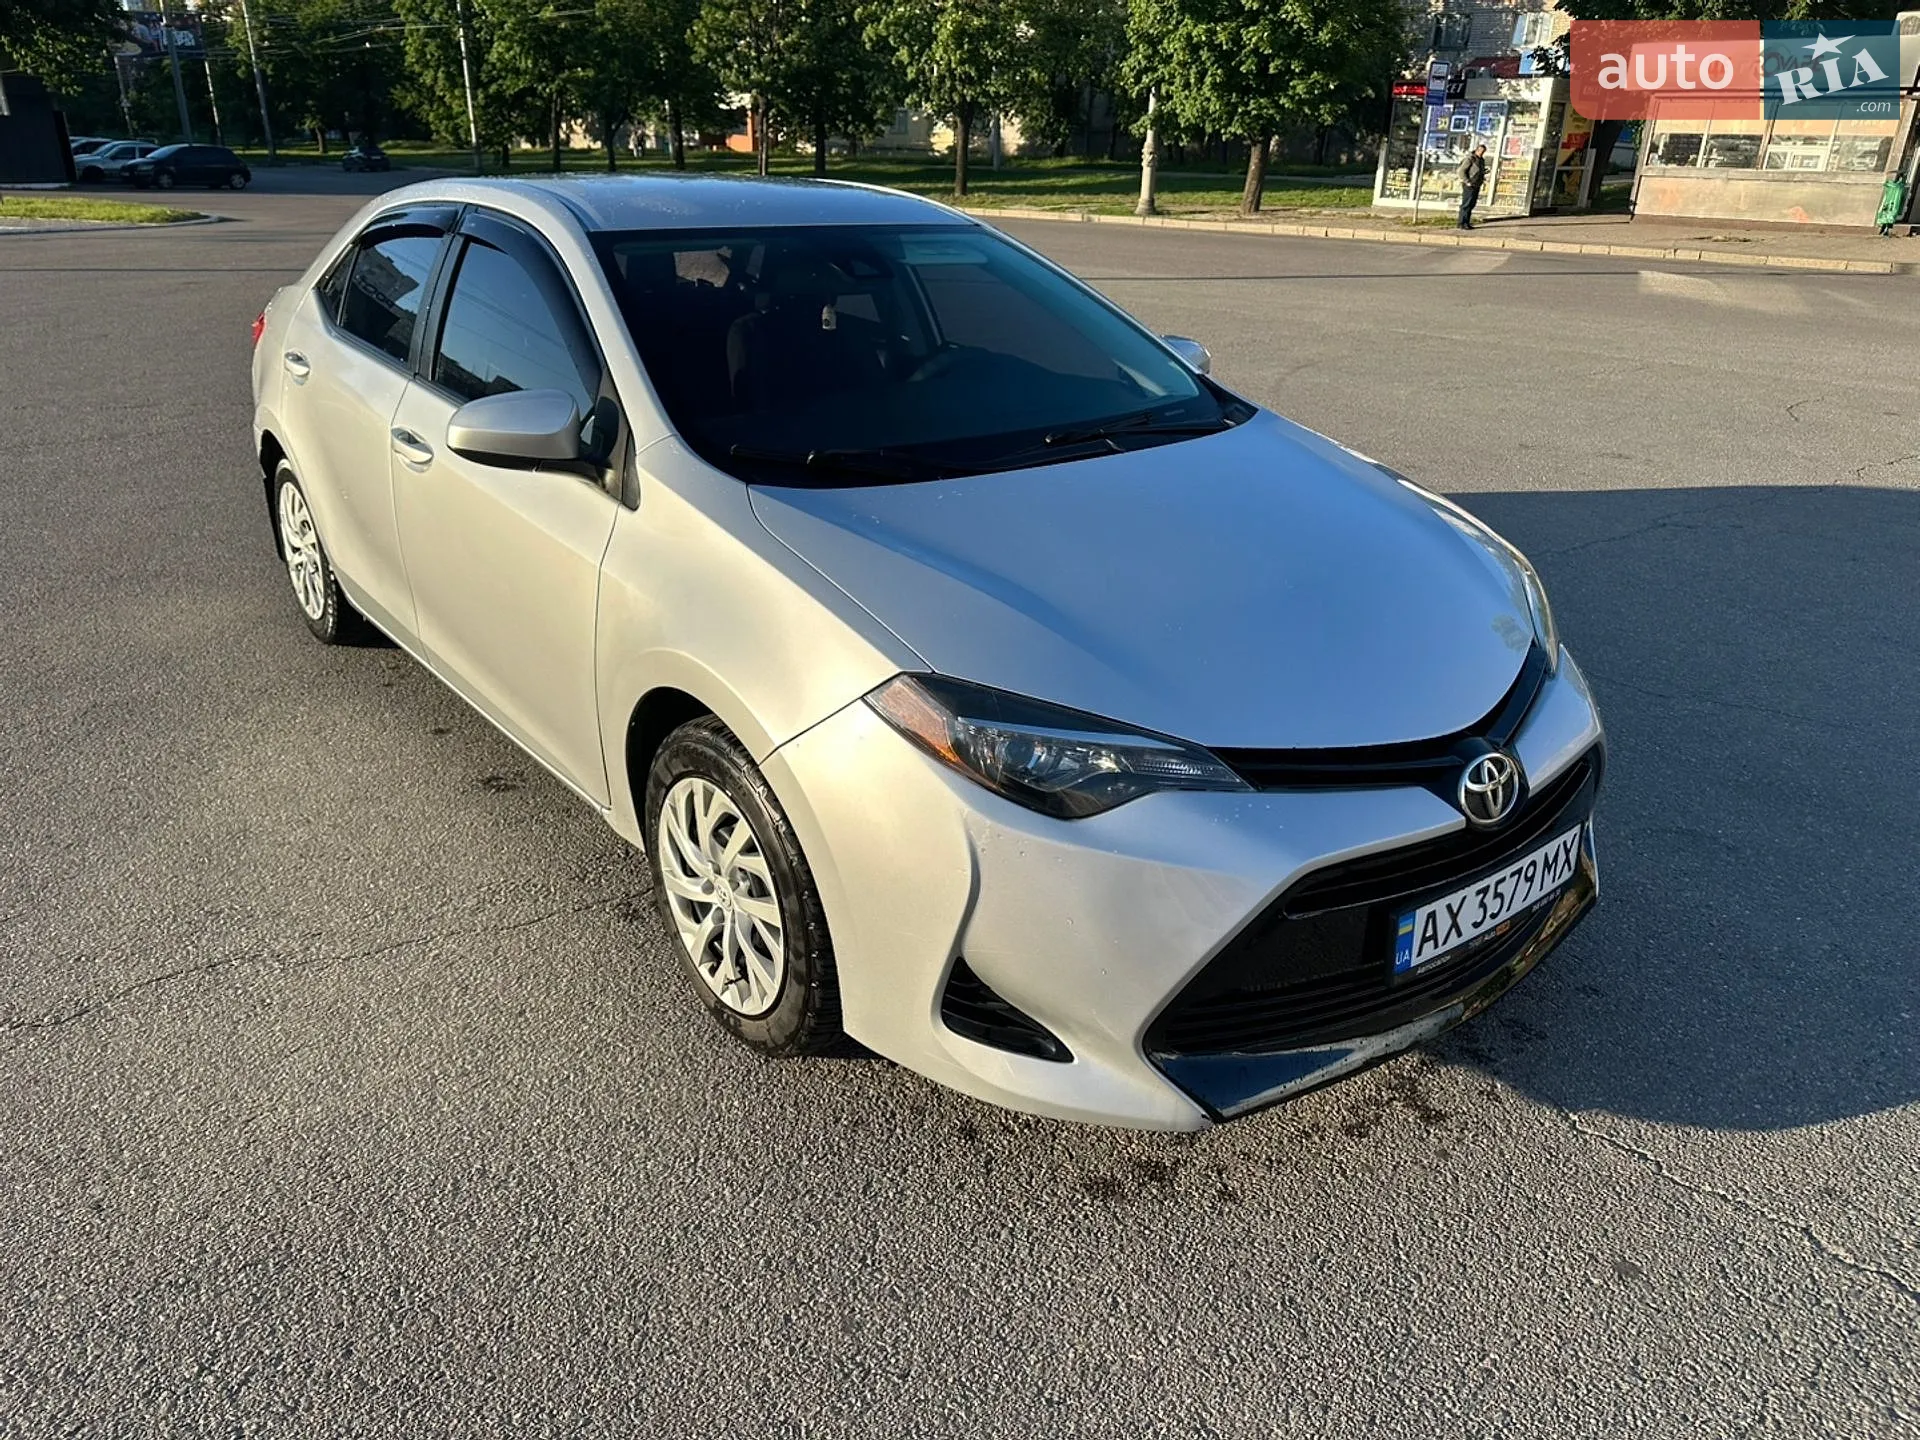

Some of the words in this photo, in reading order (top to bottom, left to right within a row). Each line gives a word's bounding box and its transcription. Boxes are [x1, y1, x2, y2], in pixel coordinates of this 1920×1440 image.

[1416, 894, 1468, 959] AX
[1471, 859, 1537, 930] 3579
[1539, 832, 1577, 891] MX
[1395, 953, 1411, 966] UA
